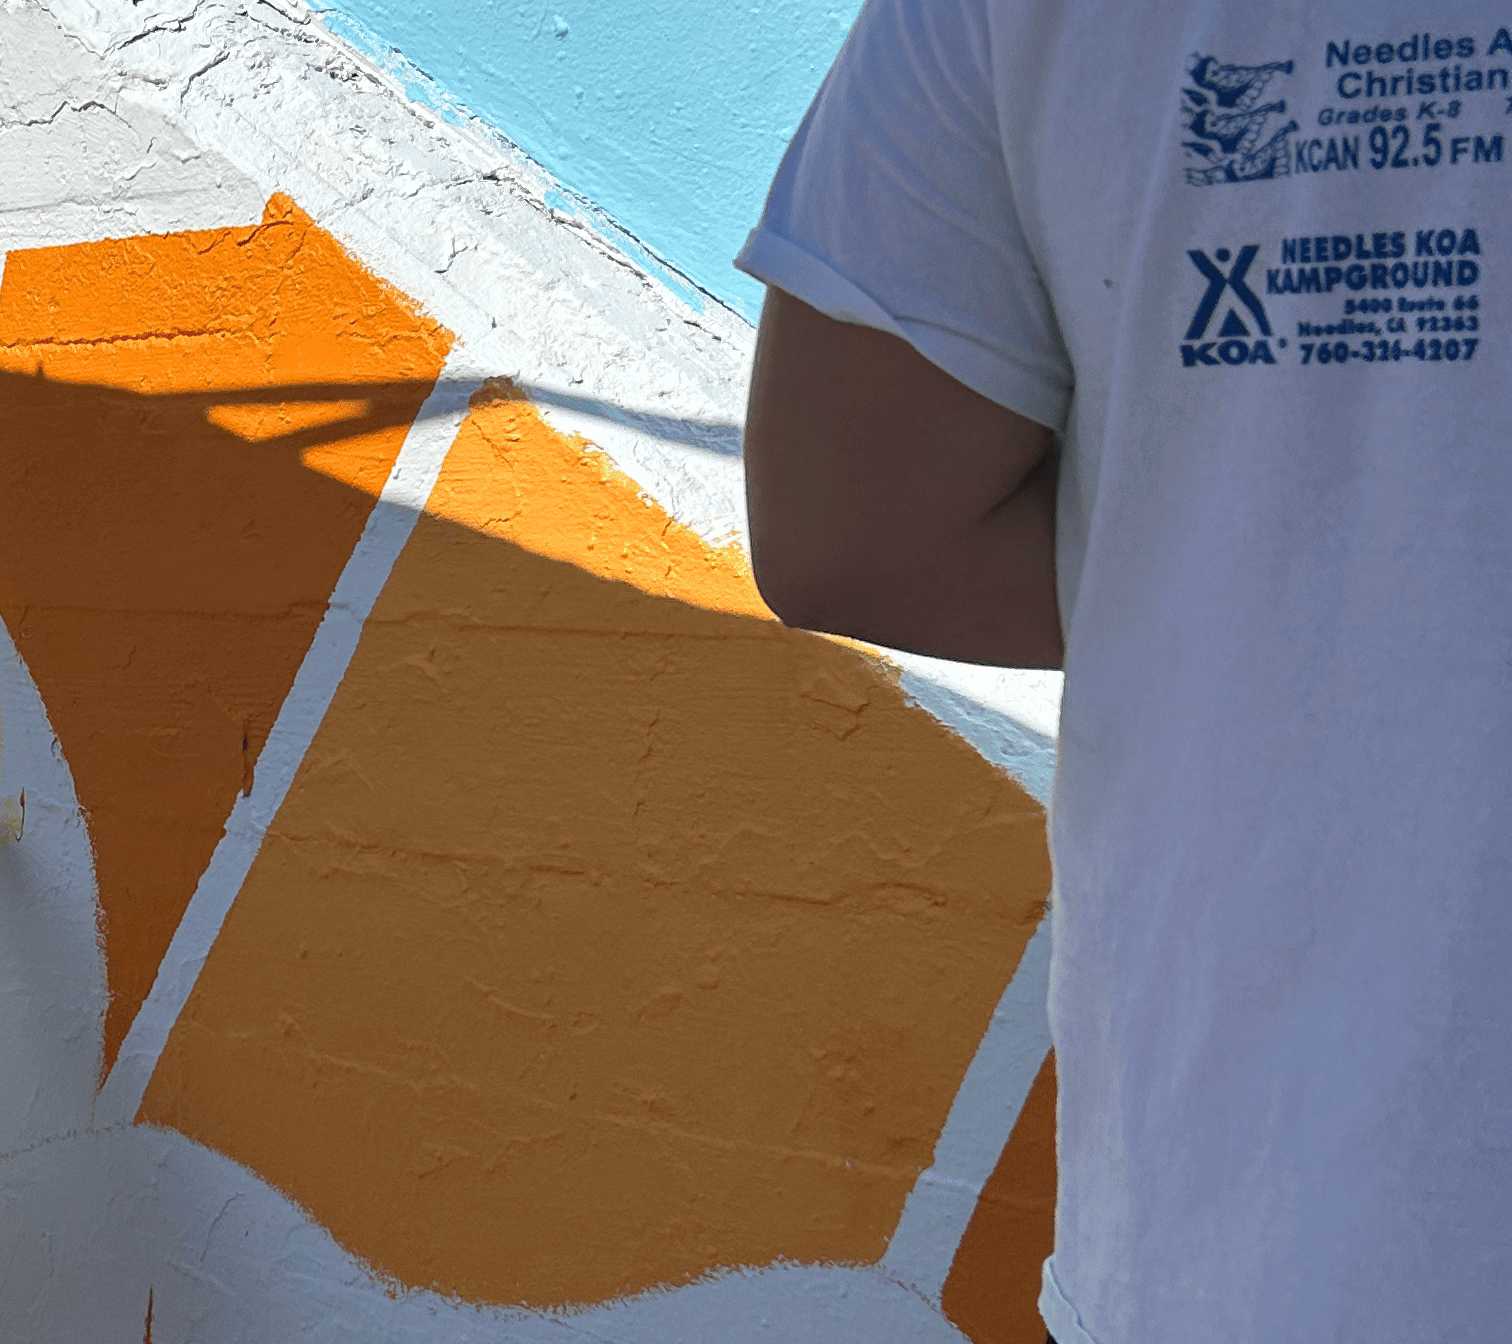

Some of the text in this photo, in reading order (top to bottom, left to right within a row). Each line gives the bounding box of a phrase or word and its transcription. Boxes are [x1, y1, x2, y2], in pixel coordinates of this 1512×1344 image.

[1326, 33, 1475, 67] Needles
[1337, 64, 1507, 99] Christian
[1318, 100, 1462, 126] Grades K-8
[1295, 123, 1504, 173] KCAN 92.5 FM
[1282, 229, 1481, 264] NEEDLES KOA
[1267, 260, 1479, 294] KAMPGROUND
[1298, 316, 1479, 337] Needles, CA 92363
[1180, 340, 1276, 367] KOA
